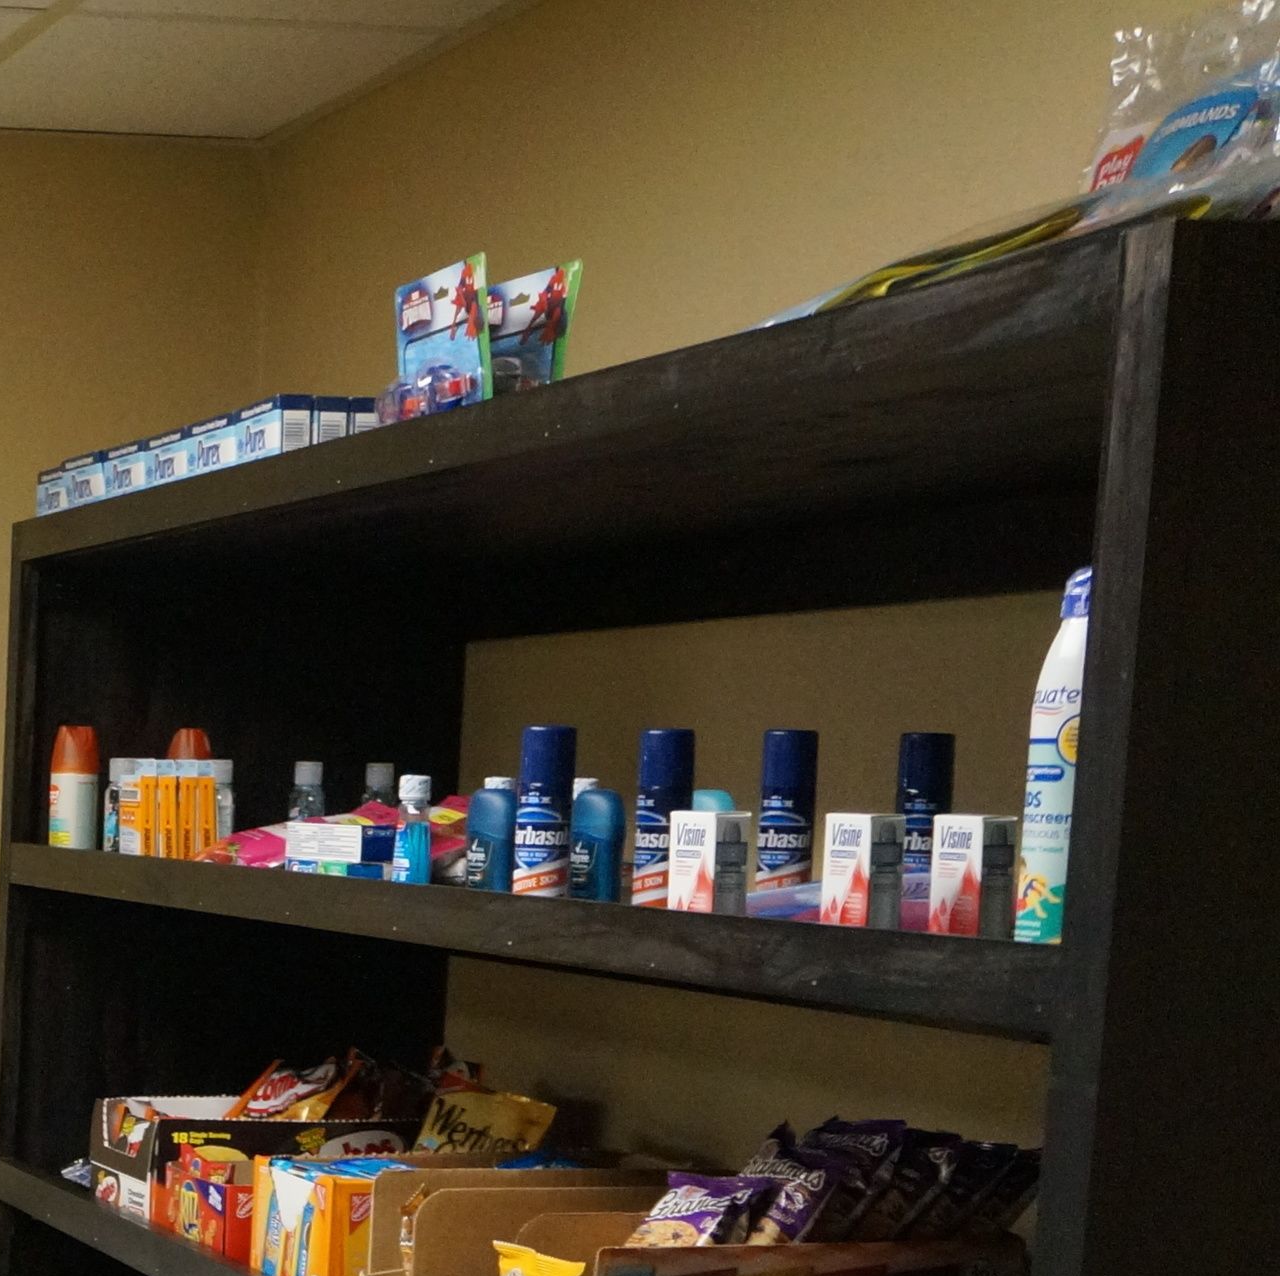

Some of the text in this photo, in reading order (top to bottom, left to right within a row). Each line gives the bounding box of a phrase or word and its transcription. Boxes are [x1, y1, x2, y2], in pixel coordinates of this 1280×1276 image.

[245, 425, 266, 455] Purex
[197, 439, 221, 469] Purex
[155, 453, 176, 480] Purex
[1034, 685, 1081, 704] uate
[515, 825, 569, 846] rbasol
[676, 823, 707, 847] Visine
[757, 829, 811, 848] rbasol
[832, 823, 863, 848] Visine
[941, 824, 973, 850] Visine
[171, 1131, 188, 1144] 18
